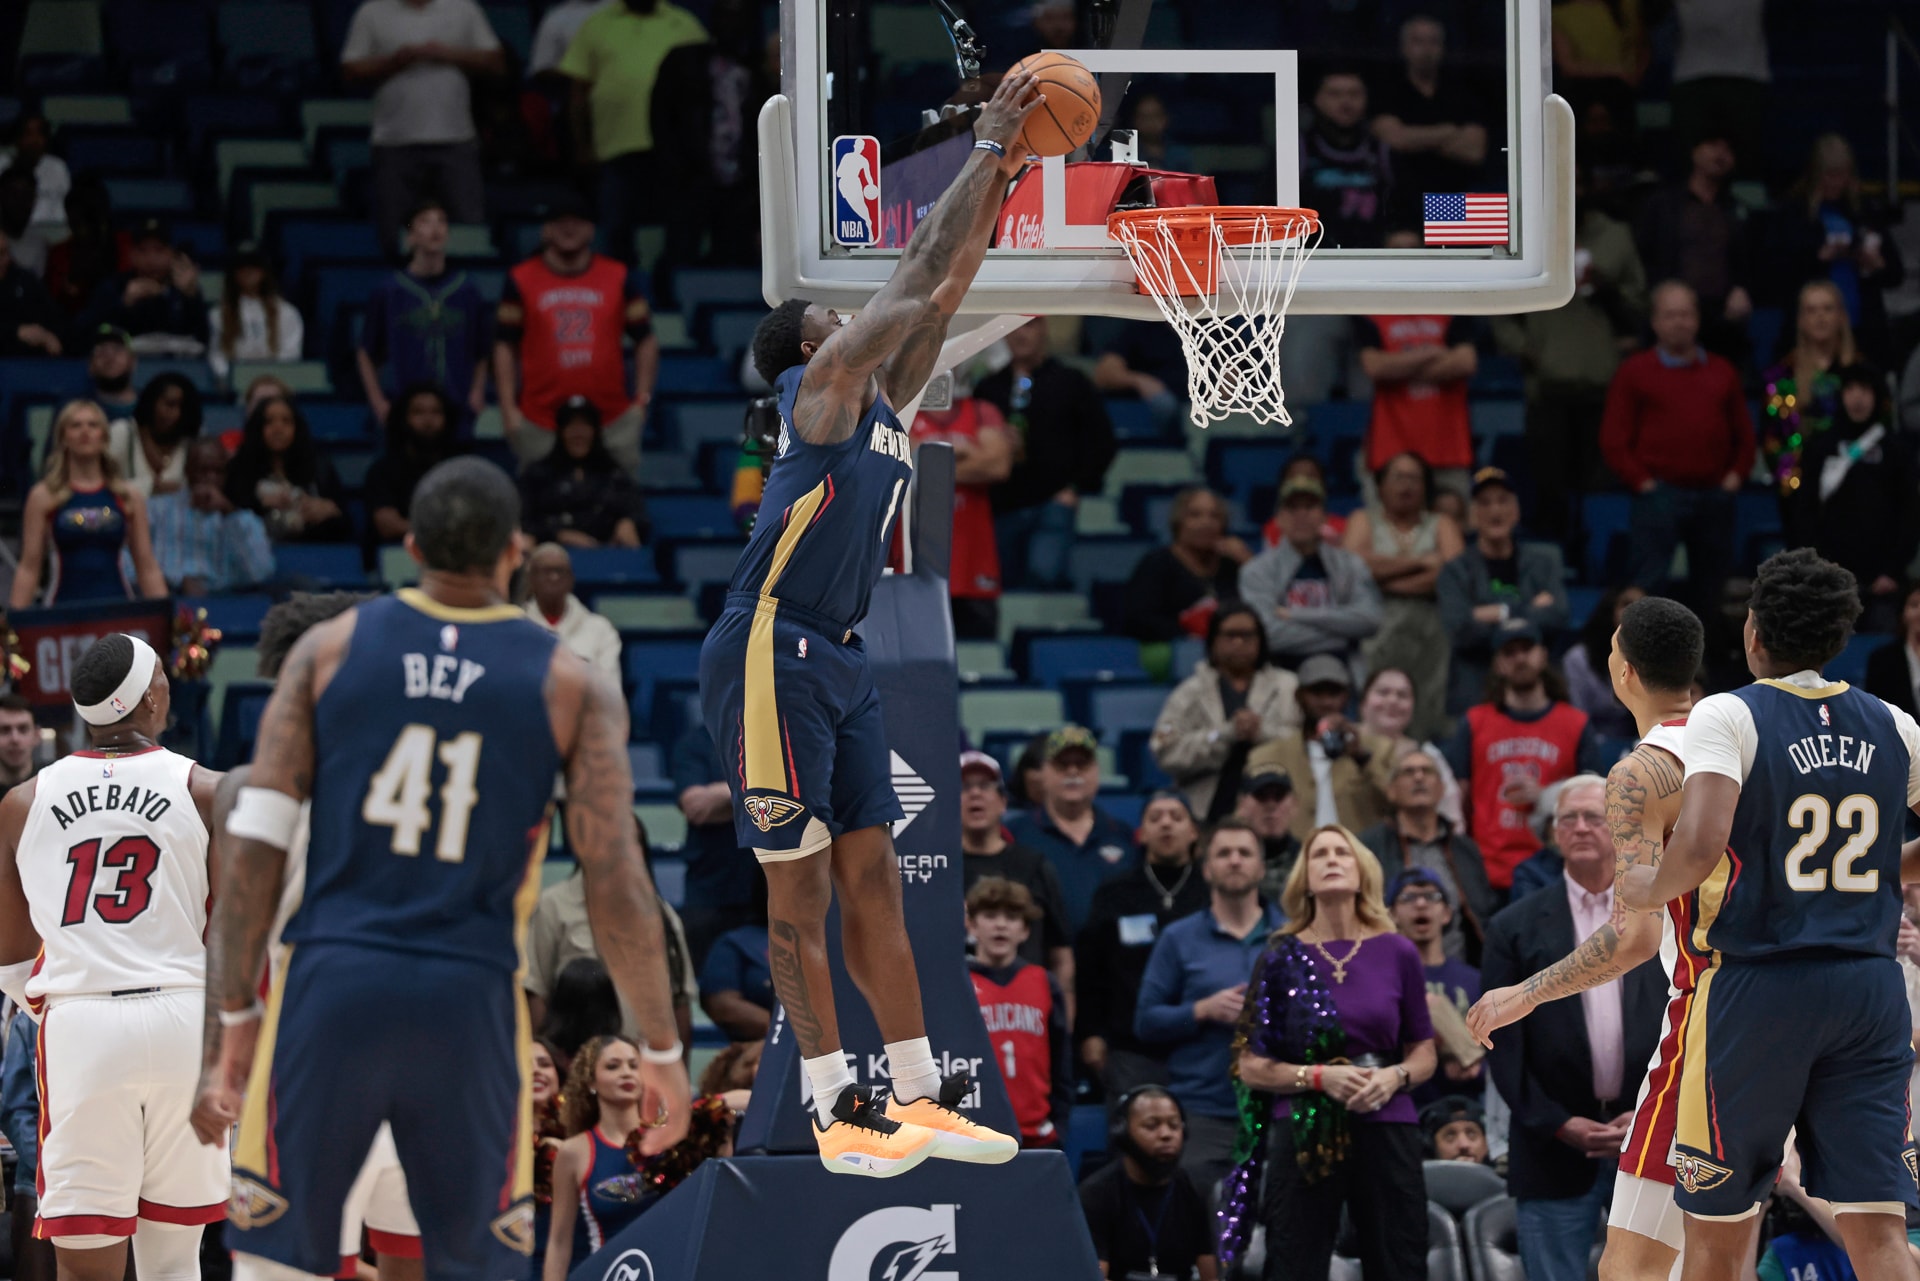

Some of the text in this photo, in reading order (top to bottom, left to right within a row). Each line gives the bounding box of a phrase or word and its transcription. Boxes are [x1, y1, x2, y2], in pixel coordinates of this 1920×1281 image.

[841, 220, 864, 238] NBA
[869, 420, 899, 459] NEW
[880, 478, 905, 543] 1
[402, 652, 486, 704] BEY
[1787, 734, 1876, 775] QUEEN
[50, 784, 172, 831] ADEBAYO
[362, 723, 482, 863] 41
[897, 854, 948, 869] ICAN
[1784, 793, 1879, 893] 22
[60, 834, 162, 928] 13
[979, 1002, 1045, 1037] ELICANS
[868, 1050, 983, 1079] Ksler
[1000, 1039, 1017, 1079] 1
